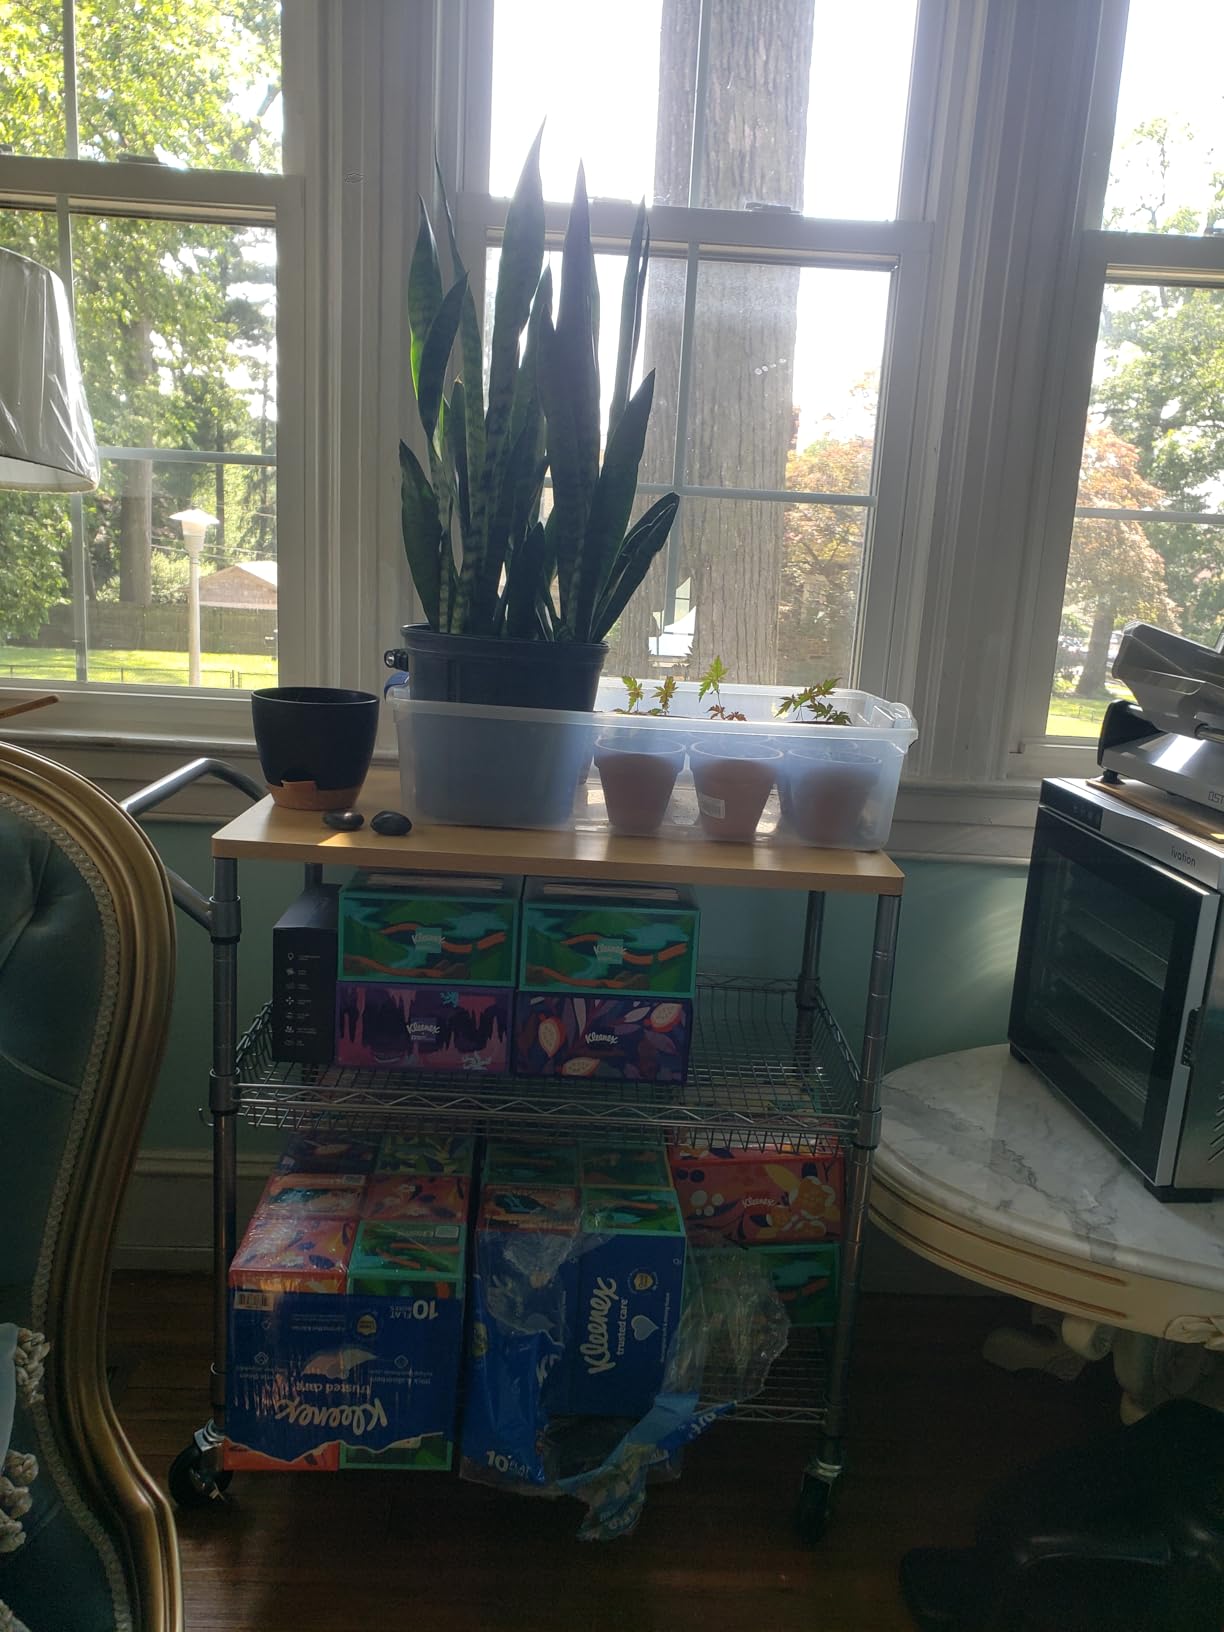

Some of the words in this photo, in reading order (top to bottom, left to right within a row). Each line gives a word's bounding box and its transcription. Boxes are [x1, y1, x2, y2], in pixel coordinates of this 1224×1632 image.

[1171, 846, 1196, 867] ivation
[411, 932, 447, 945] Kleenex
[405, 1022, 441, 1035] Kleenex
[584, 1031, 619, 1045] Kleenex
[742, 1196, 776, 1208] Kleenex
[389, 1311, 412, 1319] FLAT
[412, 1299, 439, 1320] 10
[619, 1298, 628, 1320] care
[579, 1276, 619, 1375] Kleenex
[616, 1320, 627, 1356] trusted
[325, 1382, 372, 1394] trusted
[274, 1397, 389, 1436] Kleenex
[486, 1450, 509, 1472] 10
